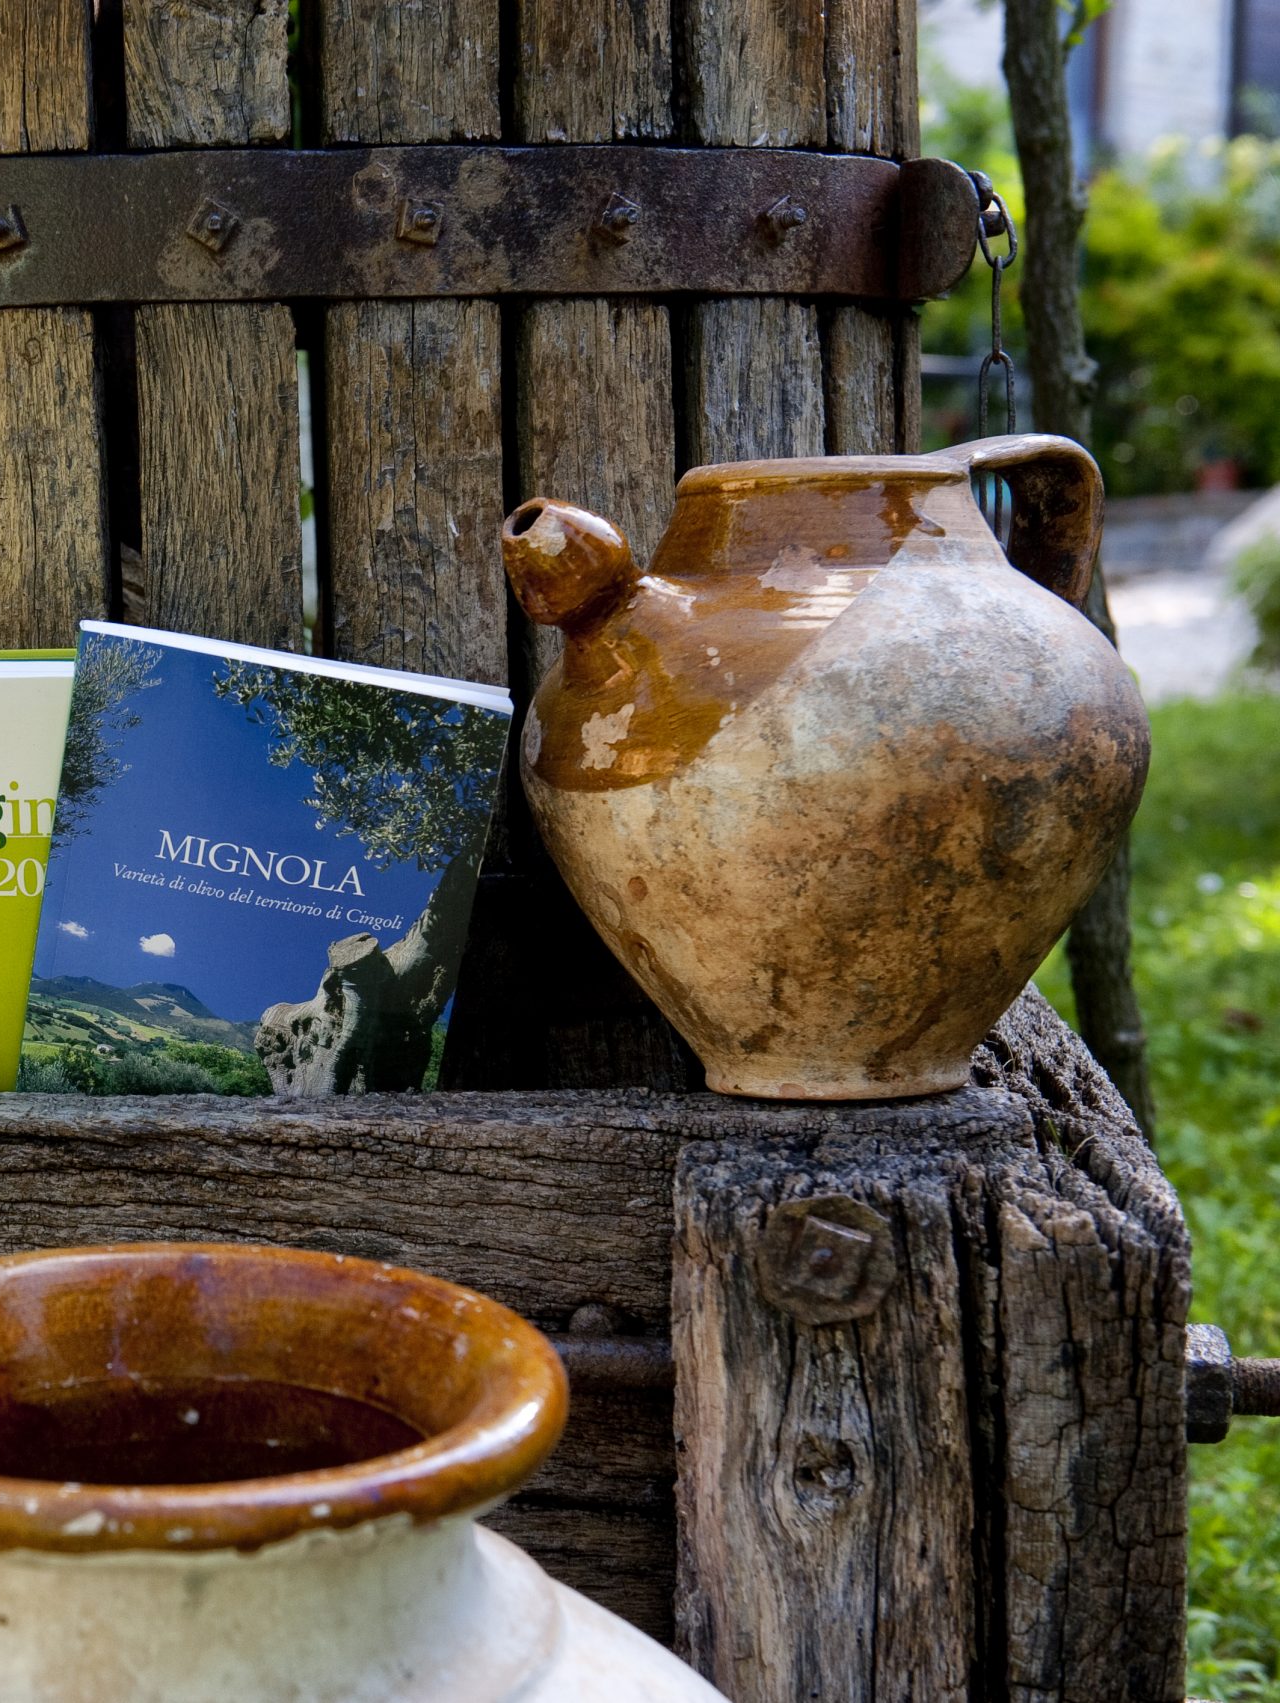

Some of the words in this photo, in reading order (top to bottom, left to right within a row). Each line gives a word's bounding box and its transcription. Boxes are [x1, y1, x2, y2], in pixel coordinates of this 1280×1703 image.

[113, 862, 165, 886] Varietà
[169, 875, 184, 891] di
[188, 879, 225, 899] olivo
[228, 887, 254, 904] del
[255, 894, 323, 917] territorio
[326, 905, 342, 920] di
[345, 908, 405, 931] Cingoli
[154, 829, 366, 897] MIGNOLA
